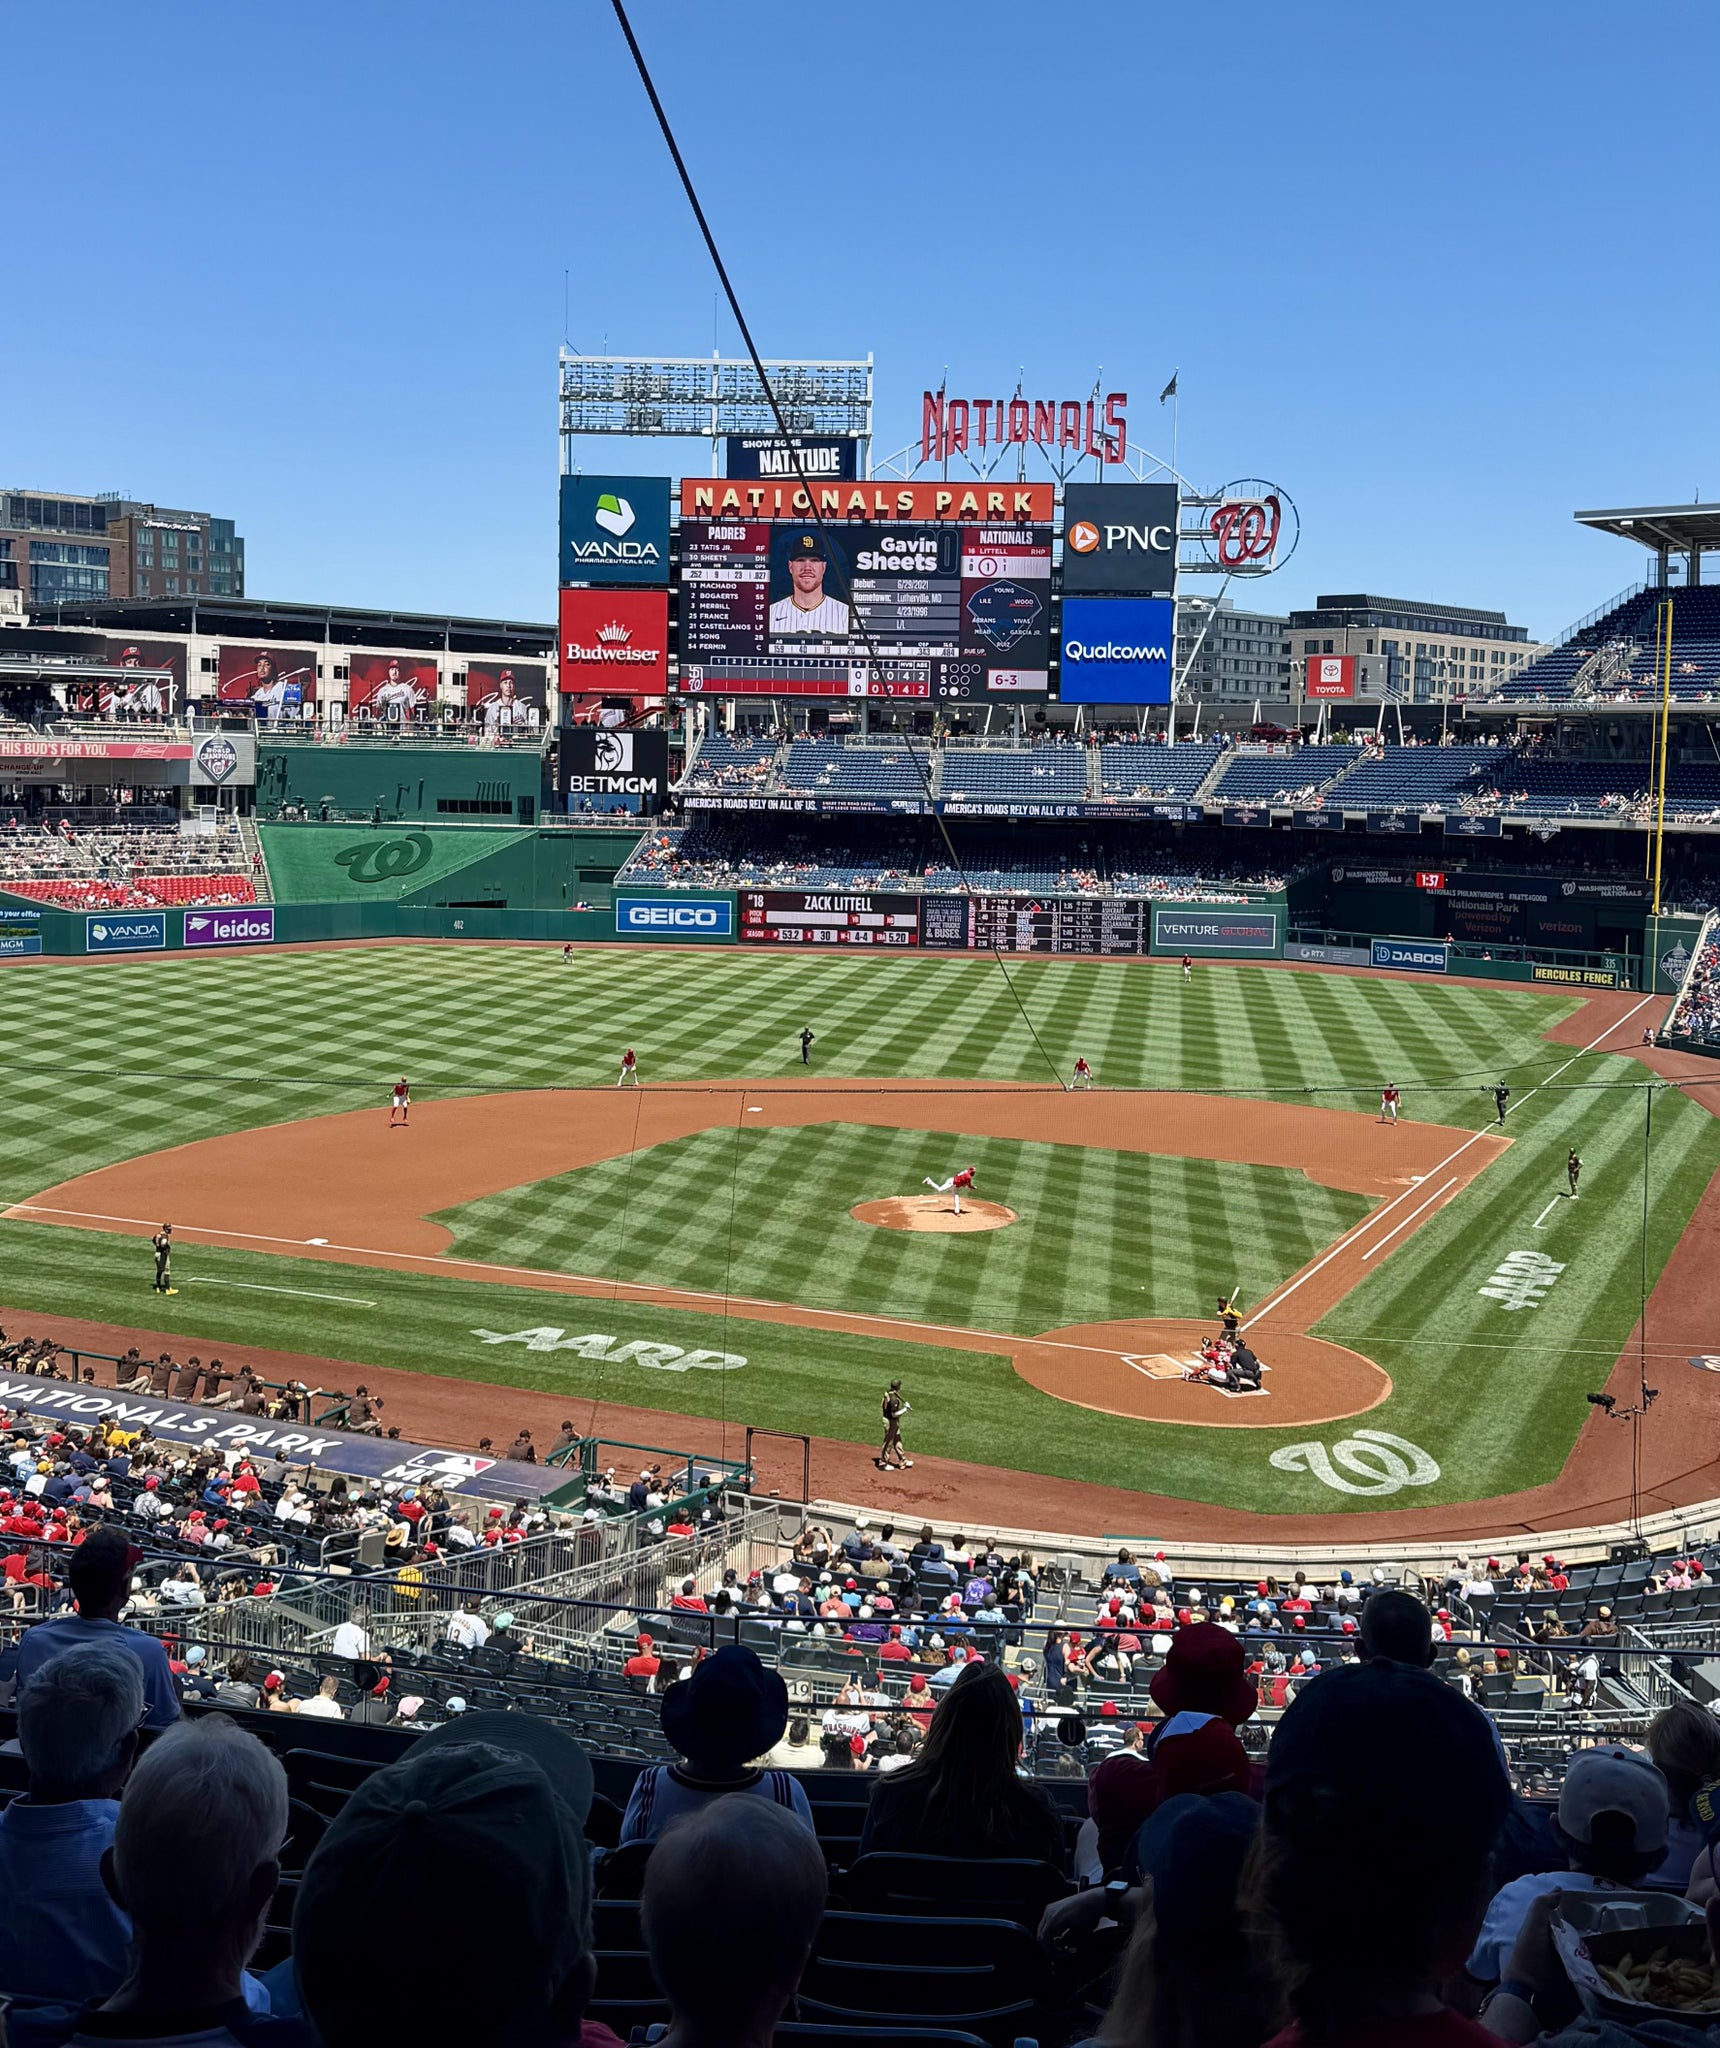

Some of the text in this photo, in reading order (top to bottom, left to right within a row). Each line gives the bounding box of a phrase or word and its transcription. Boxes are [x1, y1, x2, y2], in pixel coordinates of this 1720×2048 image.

[922, 390, 1127, 464] NATIONALS
[742, 440, 772, 449] SHOW
[695, 488, 1031, 511] NATIONALS PARK
[708, 527, 746, 540] PADRES
[979, 531, 1033, 545] NATIONALS
[1104, 525, 1172, 551] PNC
[571, 541, 659, 558] VANDA
[881, 536, 937, 553] Gavin
[856, 552, 937, 571] Sheets
[854, 579, 928, 590] Debut: 6/29/2021
[853, 593, 891, 602] Hometown:
[566, 643, 660, 661] Budweiser
[799, 646, 808, 654] 40
[1065, 641, 1167, 661] Qualcomm
[940, 664, 947, 673] B
[855, 671, 925, 681] 0 0 0 4 2
[940, 675, 947, 684] S
[994, 674, 1018, 685] 6-3
[855, 684, 925, 694] 0 0 4 2
[1315, 686, 1346, 694] TOYOTA
[24, 743, 109, 757] BUD'S FOR YOU.
[570, 775, 657, 794] BETMGM
[684, 797, 817, 811] AMERICA'S ROADS RELY ON ALL OF US.
[944, 803, 1079, 816] AMERICA'S ROADS RELY ON ALL OF US.
[1346, 870, 1389, 880] WASHINGTON
[1366, 875, 1402, 884] NATIONALS
[1421, 873, 1440, 887] 1:37
[1426, 889, 1455, 898] NATIONALS
[1457, 891, 1504, 900] PHILANTHROPIES
[1578, 885, 1627, 894] WASHINGTON
[1601, 889, 1643, 897] NATIONALS
[748, 894, 764, 908] #18
[804, 895, 873, 912] ZACK LITTELL
[1448, 899, 1519, 913] Nationals Park
[4, 909, 20, 920] your
[21, 909, 40, 918] office
[629, 907, 717, 926] GEICO
[1455, 911, 1512, 923] powered by
[108, 924, 160, 936] VANDA
[213, 919, 271, 942] leidos
[1163, 924, 1269, 941] VENTURE GLOBAL
[1465, 922, 1502, 933] Verizon
[1539, 921, 1582, 933] verizon
[782, 930, 906, 943] 53.2 30 4-4 5.20
[935, 929, 961, 939] BUSES.
[0, 940, 24, 949] MGM
[1310, 949, 1326, 962] RTX
[1391, 951, 1444, 965] DABOS
[1604, 958, 1616, 969] 335
[1534, 967, 1614, 985] HERCULES FENCE
[468, 1326, 748, 1372] AARP
[0, 1380, 344, 1457] NATIONALS PARK
[382, 1464, 467, 1489] MLB
[791, 1683, 810, 1697] 19
